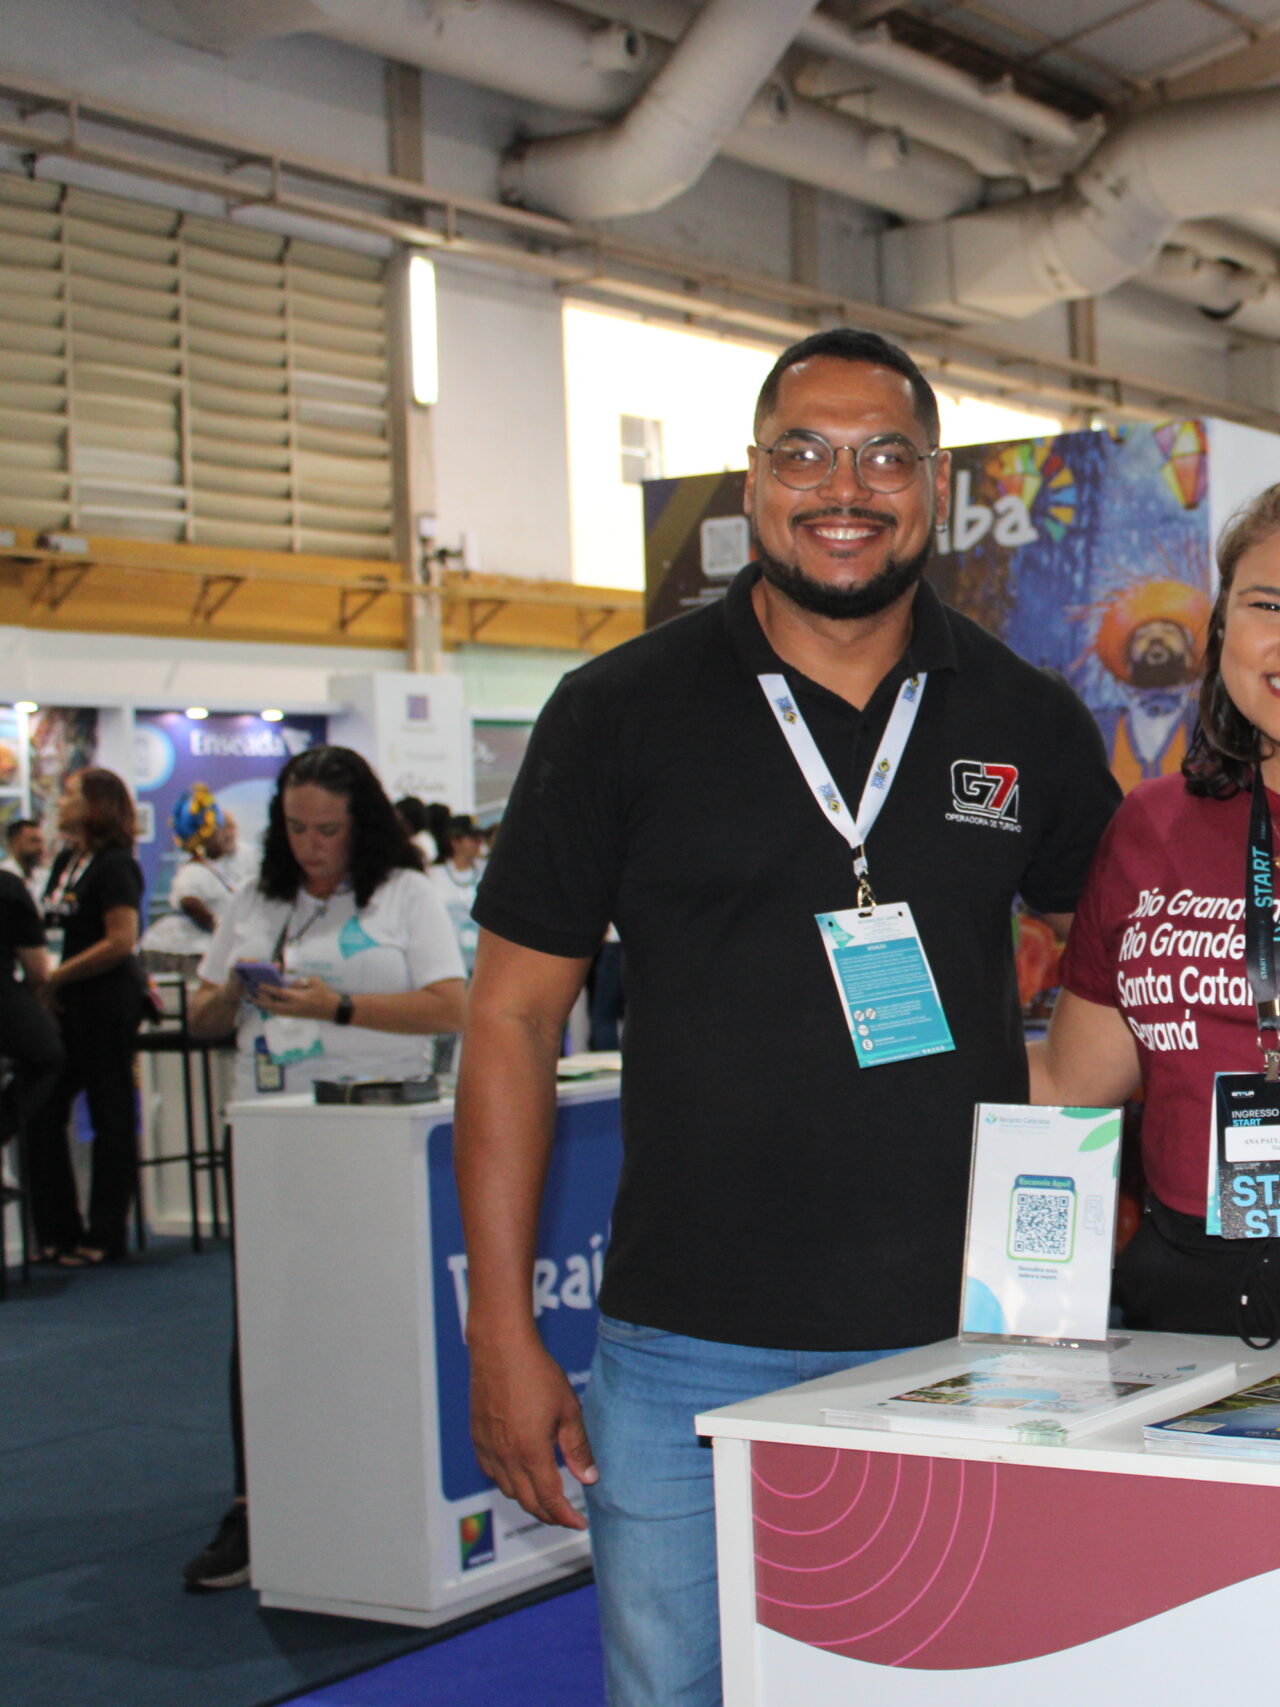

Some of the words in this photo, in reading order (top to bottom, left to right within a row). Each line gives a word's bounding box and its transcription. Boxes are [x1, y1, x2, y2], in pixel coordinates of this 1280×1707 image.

[950, 760, 1019, 812] G7
[1252, 846, 1274, 907] START
[1119, 922, 1147, 962] Rio
[1150, 922, 1247, 960] Grande
[1117, 967, 1172, 1007] Santa
[1231, 1108, 1280, 1119] INGRESSO
[1232, 1118, 1262, 1127] START
